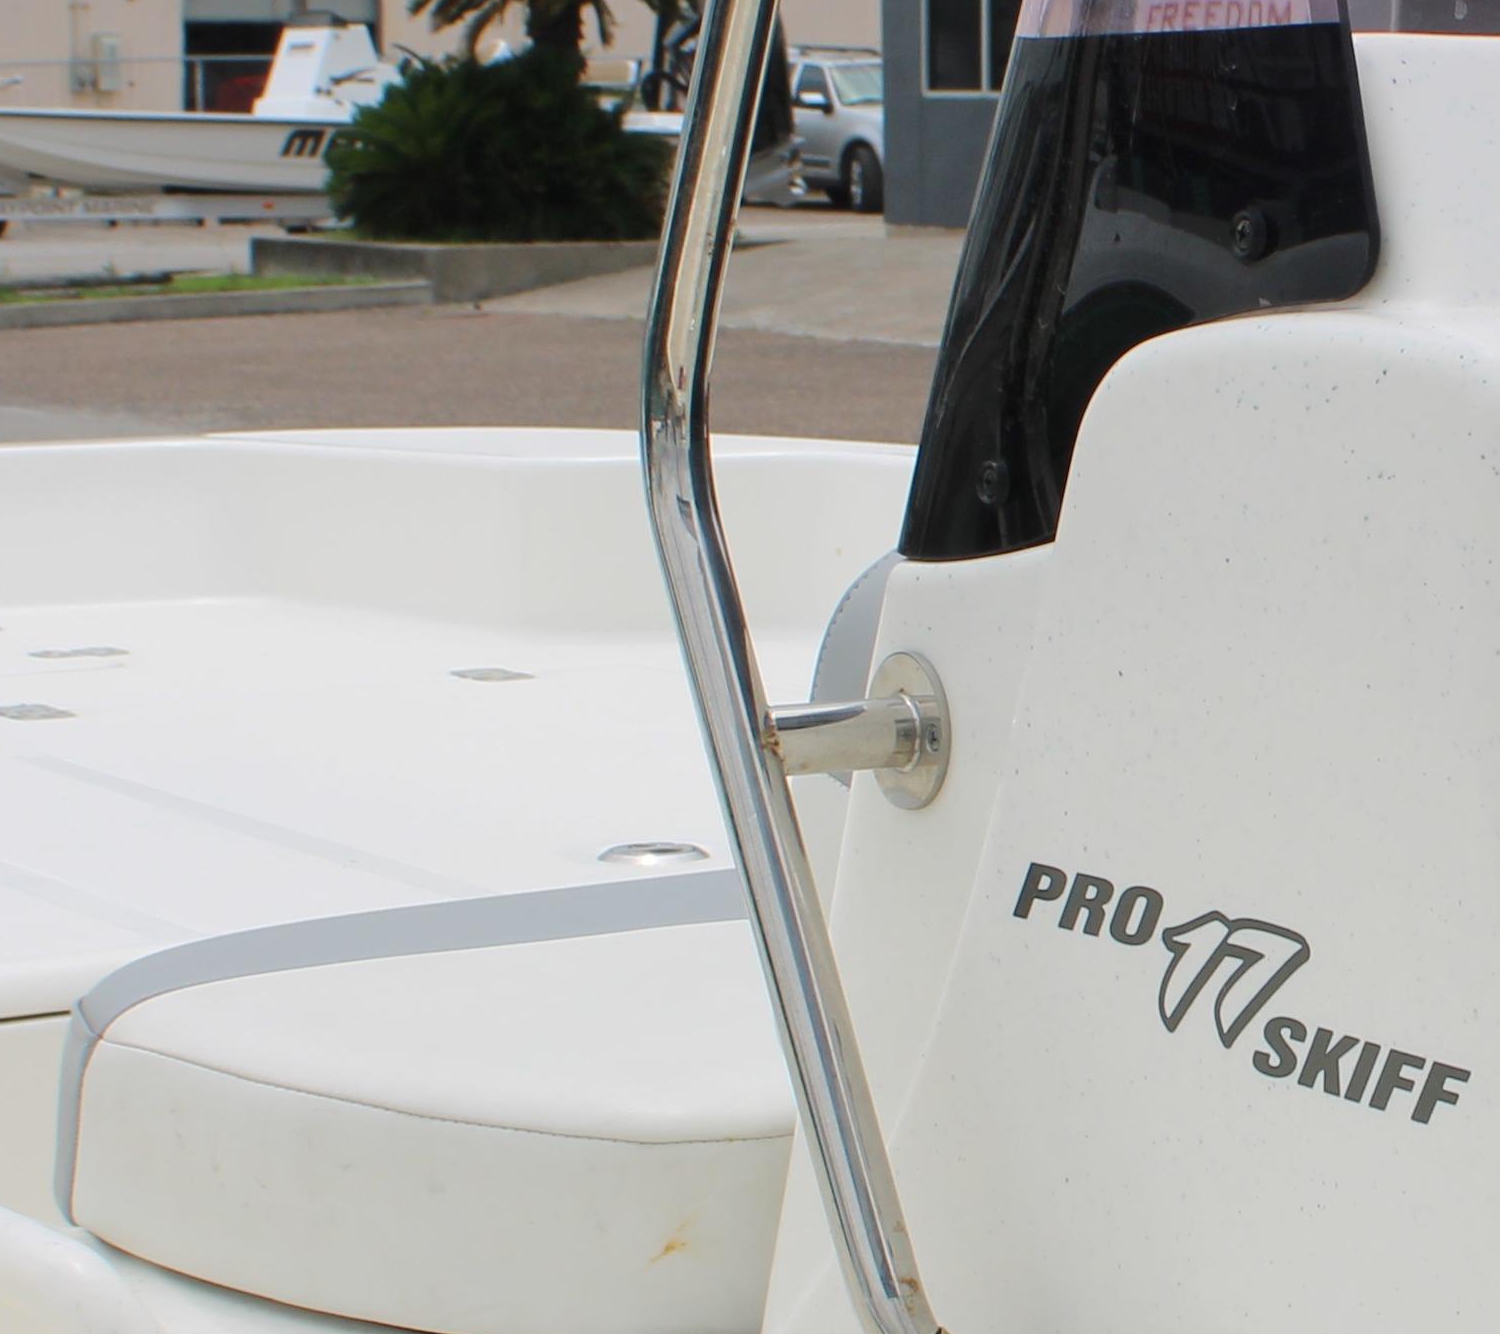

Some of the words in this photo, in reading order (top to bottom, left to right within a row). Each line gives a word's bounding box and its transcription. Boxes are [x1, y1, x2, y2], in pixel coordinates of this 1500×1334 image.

[1148, 0, 1292, 31] FREEDOM
[1013, 862, 1164, 946] PRO
[1159, 910, 1311, 1049] 17
[1252, 1016, 1471, 1125] SKIFF
